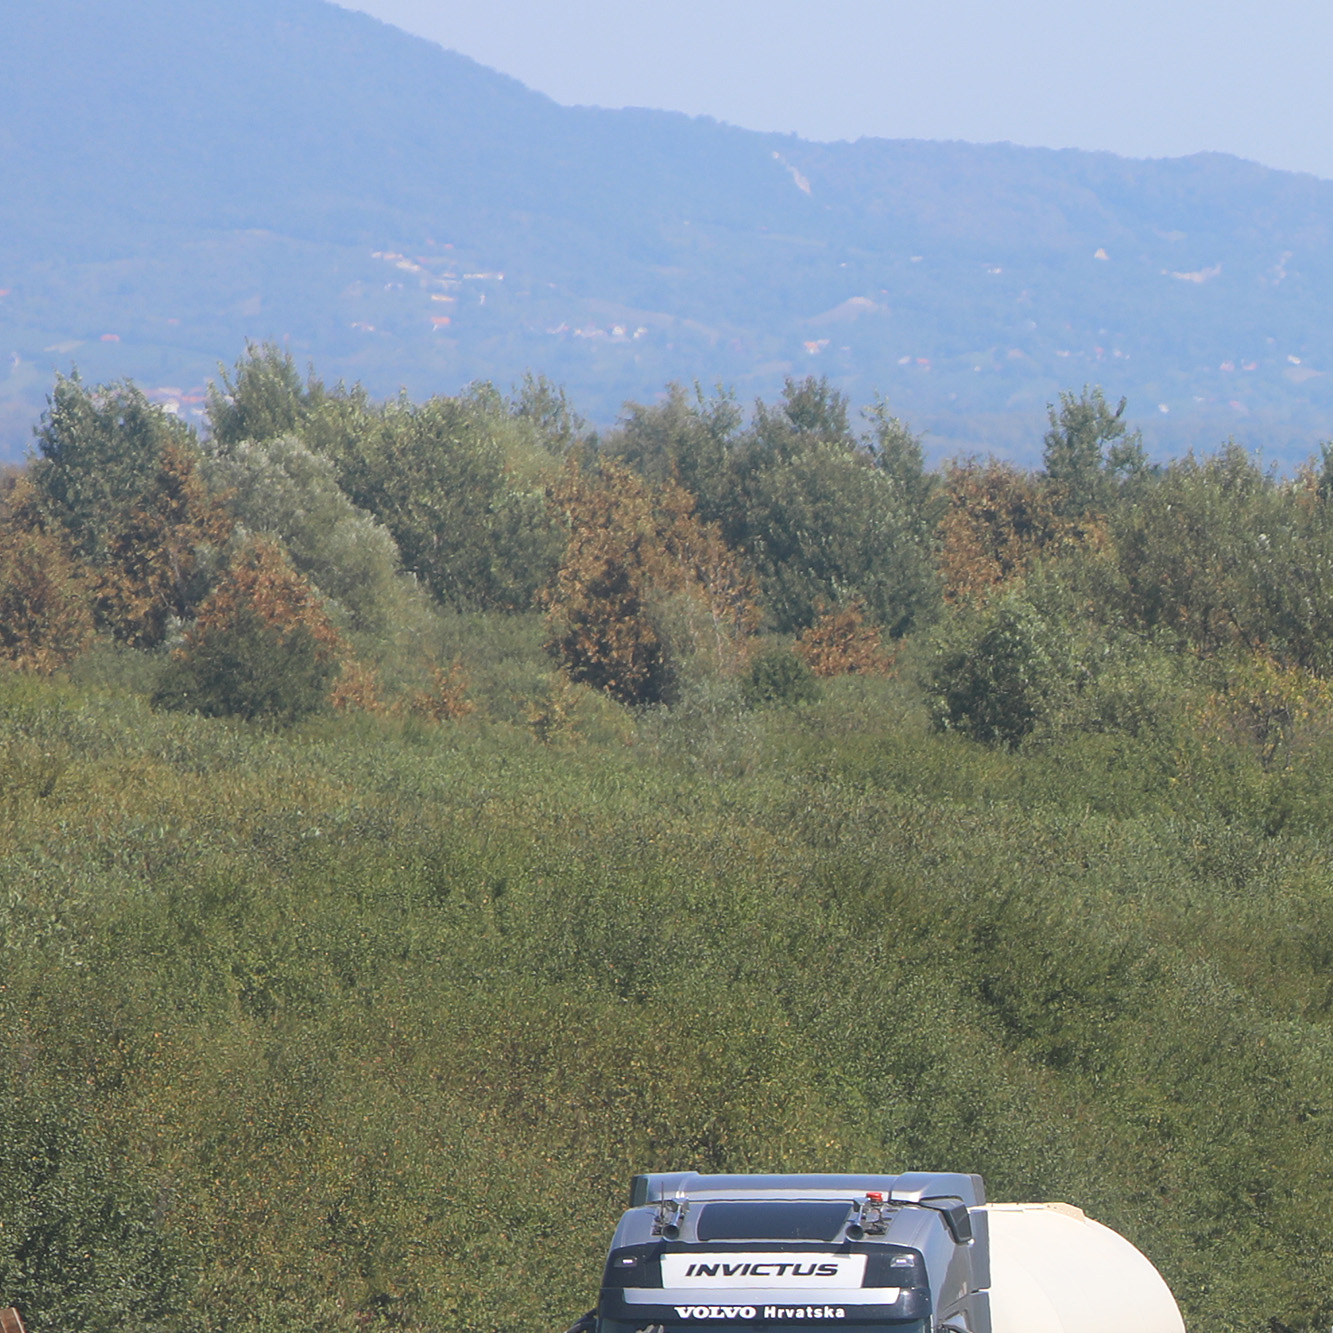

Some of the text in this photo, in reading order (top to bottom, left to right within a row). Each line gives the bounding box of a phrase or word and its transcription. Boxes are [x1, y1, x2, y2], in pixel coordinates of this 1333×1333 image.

[685, 1263, 839, 1277] INVICTUS
[674, 1306, 846, 1319] VOLVO Hrvatska
